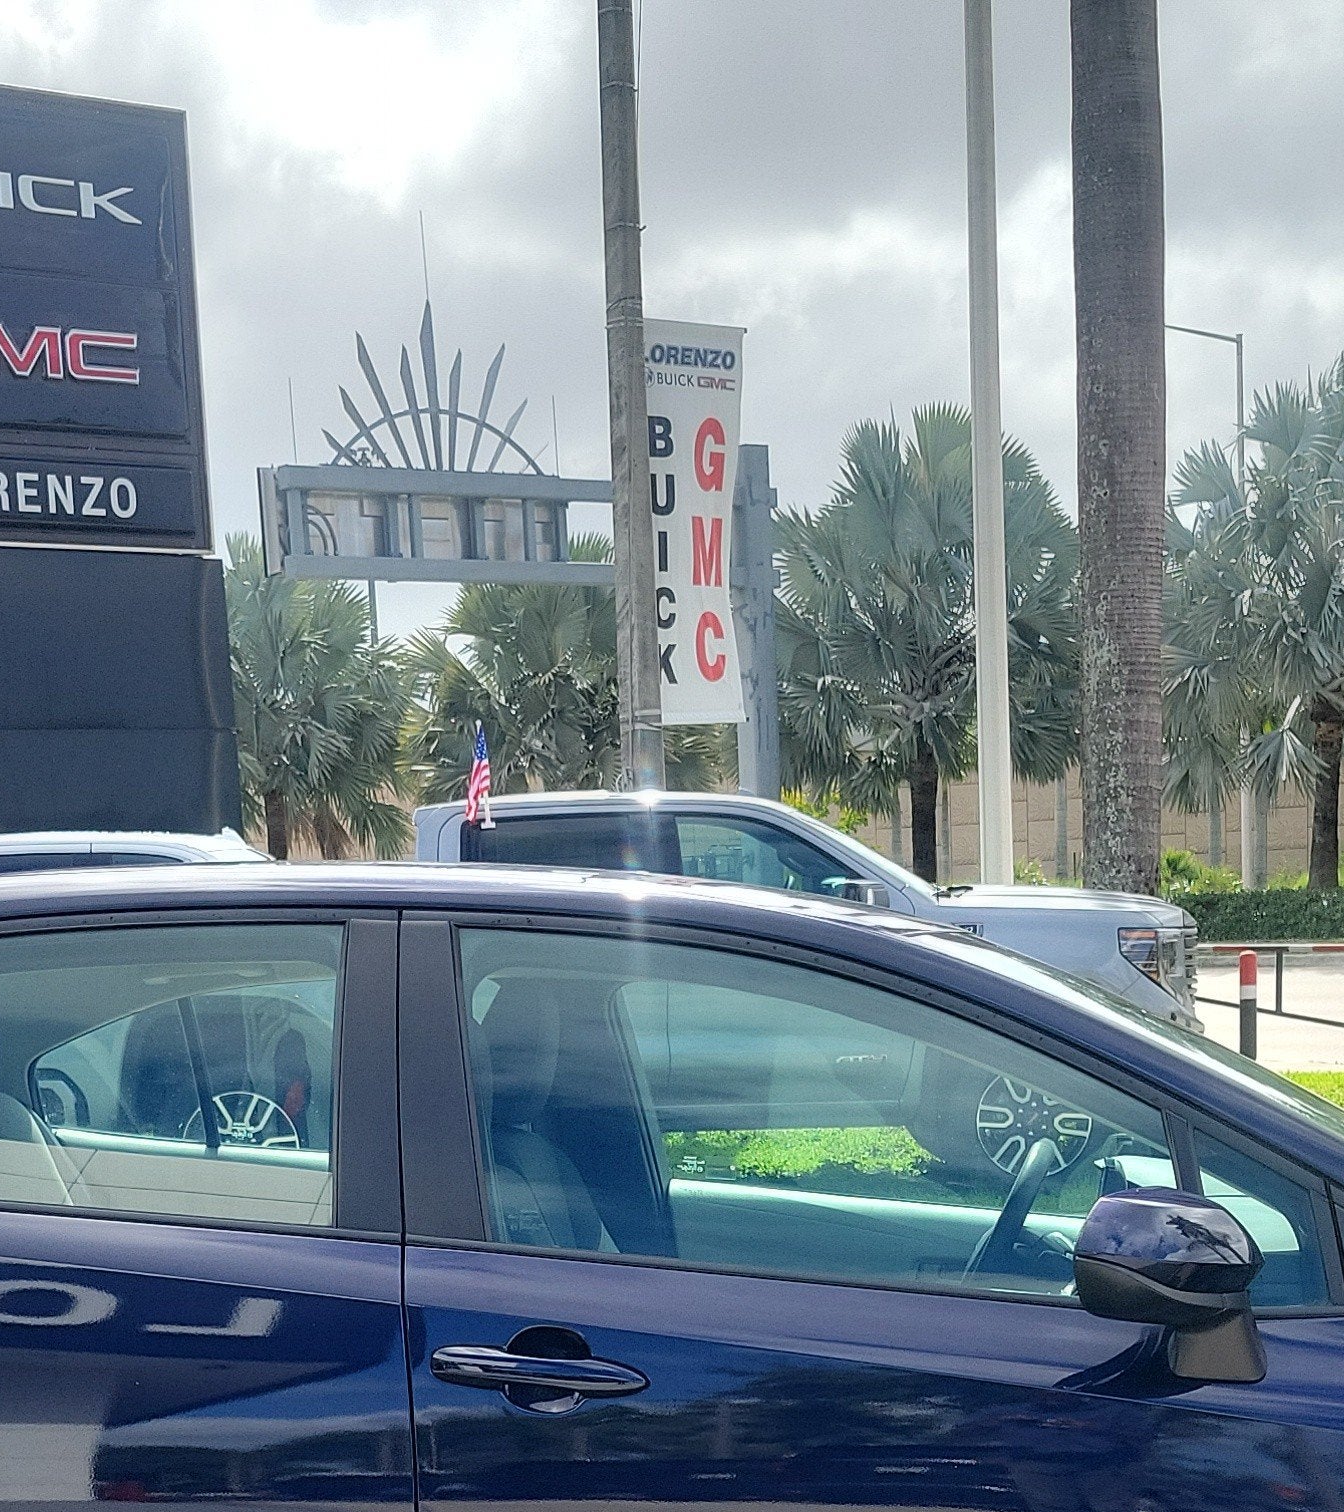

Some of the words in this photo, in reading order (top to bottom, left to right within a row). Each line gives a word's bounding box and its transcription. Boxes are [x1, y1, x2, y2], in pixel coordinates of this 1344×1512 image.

[645, 344, 735, 369] ORENZO
[657, 372, 694, 387] BUICK
[697, 376, 736, 391] GMC
[647, 416, 678, 685] BUICK
[692, 417, 727, 682] GMC
